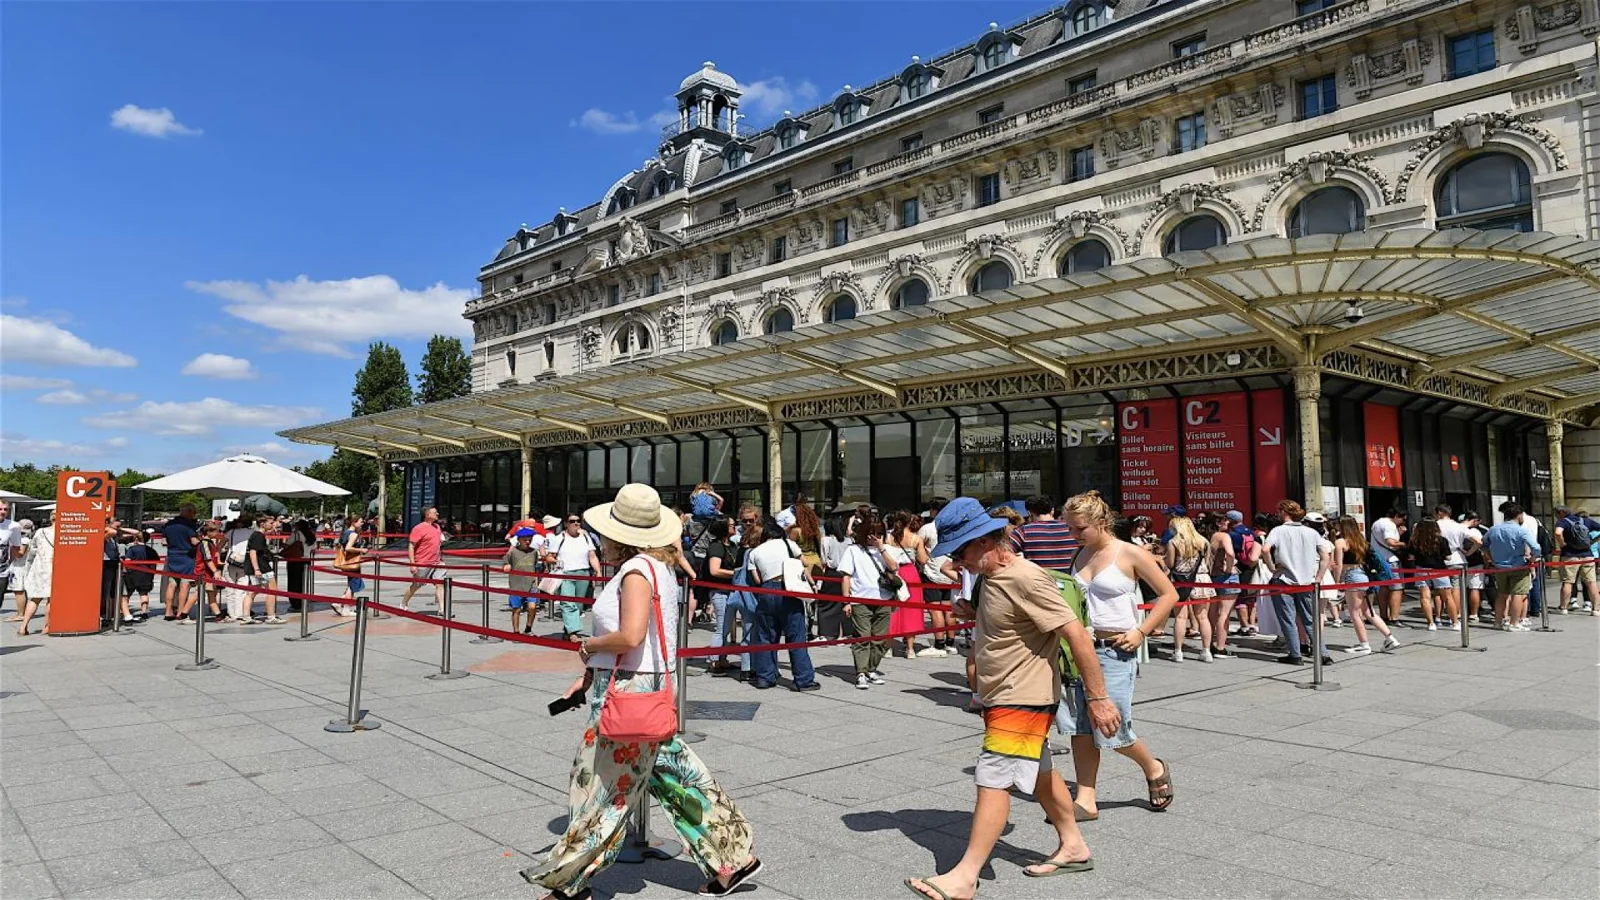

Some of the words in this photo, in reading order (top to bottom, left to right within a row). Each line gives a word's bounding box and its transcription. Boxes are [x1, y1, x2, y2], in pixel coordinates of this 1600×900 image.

[1185, 400, 1221, 426] C2
[1122, 406, 1151, 430] C1
[1121, 435, 1145, 444] Billet
[1185, 431, 1227, 440] Visiteurs
[1143, 443, 1175, 453] horaire
[1185, 442, 1207, 450] sans
[1209, 440, 1235, 449] billet
[1186, 456, 1222, 465] Visitors
[1387, 445, 1396, 469] C
[1122, 459, 1149, 468] Ticket
[1122, 468, 1155, 477] without
[1186, 466, 1222, 475] without
[1143, 478, 1159, 486] slot
[1186, 477, 1214, 485] ticket
[66, 475, 103, 498] C2
[1122, 492, 1151, 501] Billete
[1187, 491, 1235, 500] Visitantes
[1123, 502, 1136, 510] sin
[1137, 501, 1169, 510] horario
[1188, 502, 1202, 510] sin
[1204, 501, 1235, 510] billete
